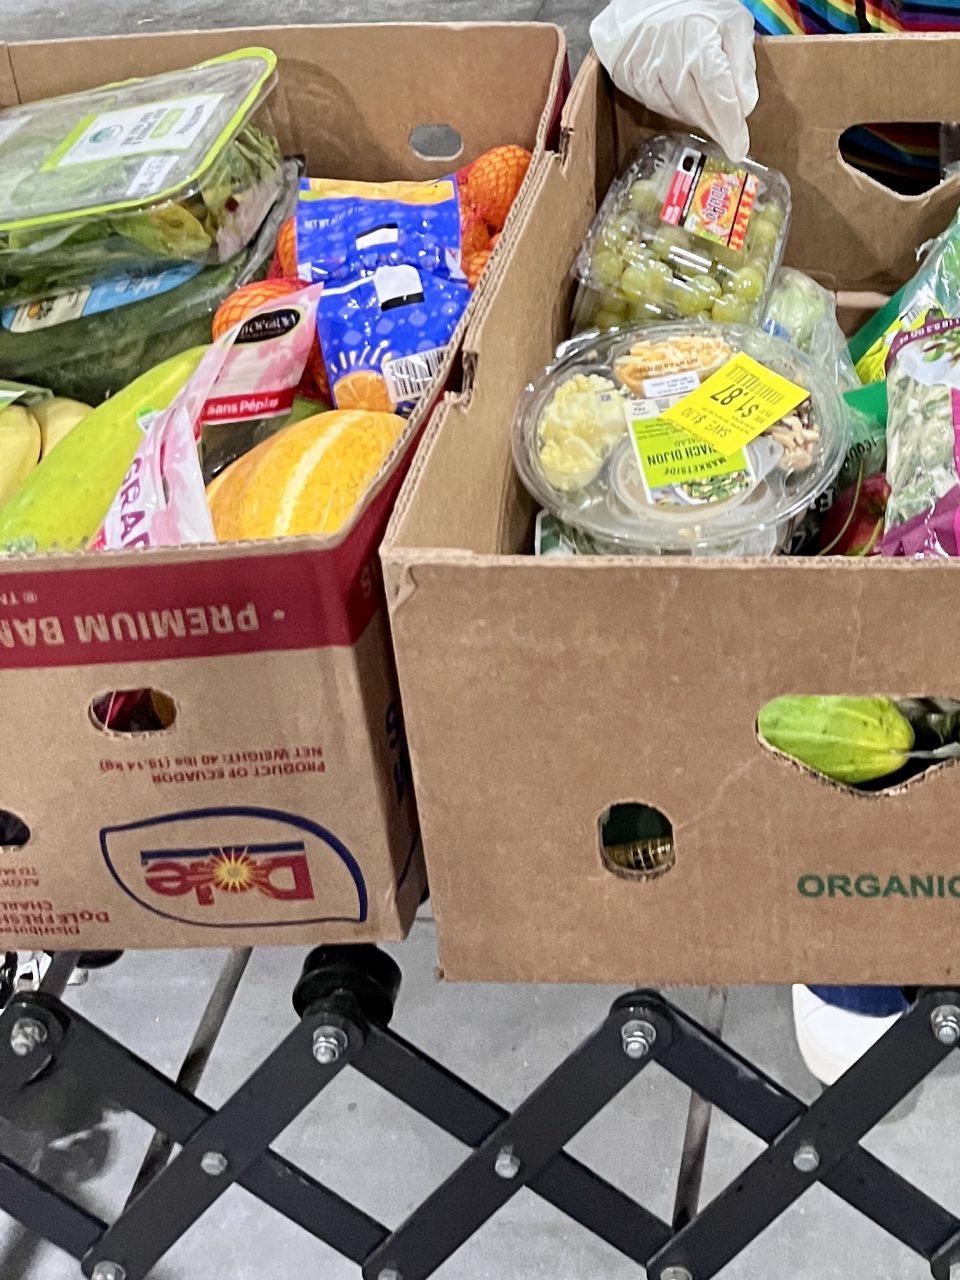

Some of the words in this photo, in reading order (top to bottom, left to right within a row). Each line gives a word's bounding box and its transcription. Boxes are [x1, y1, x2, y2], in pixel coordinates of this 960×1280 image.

[709, 383, 760, 418] $1.87
[206, 403, 238, 416] sans
[647, 449, 682, 466] DIJON
[663, 457, 728, 477] MARKETSIDE
[73, 601, 260, 643] PREMIUM
[201, 754, 218, 764] 40
[223, 748, 290, 762] WEIGHT:
[295, 747, 323, 759] NET
[151, 768, 225, 784] ECUADOR
[228, 767, 249, 779] OF
[254, 760, 326, 778] PRODUCT
[143, 854, 315, 907] Dole
[57, 910, 111, 924] DOLE
